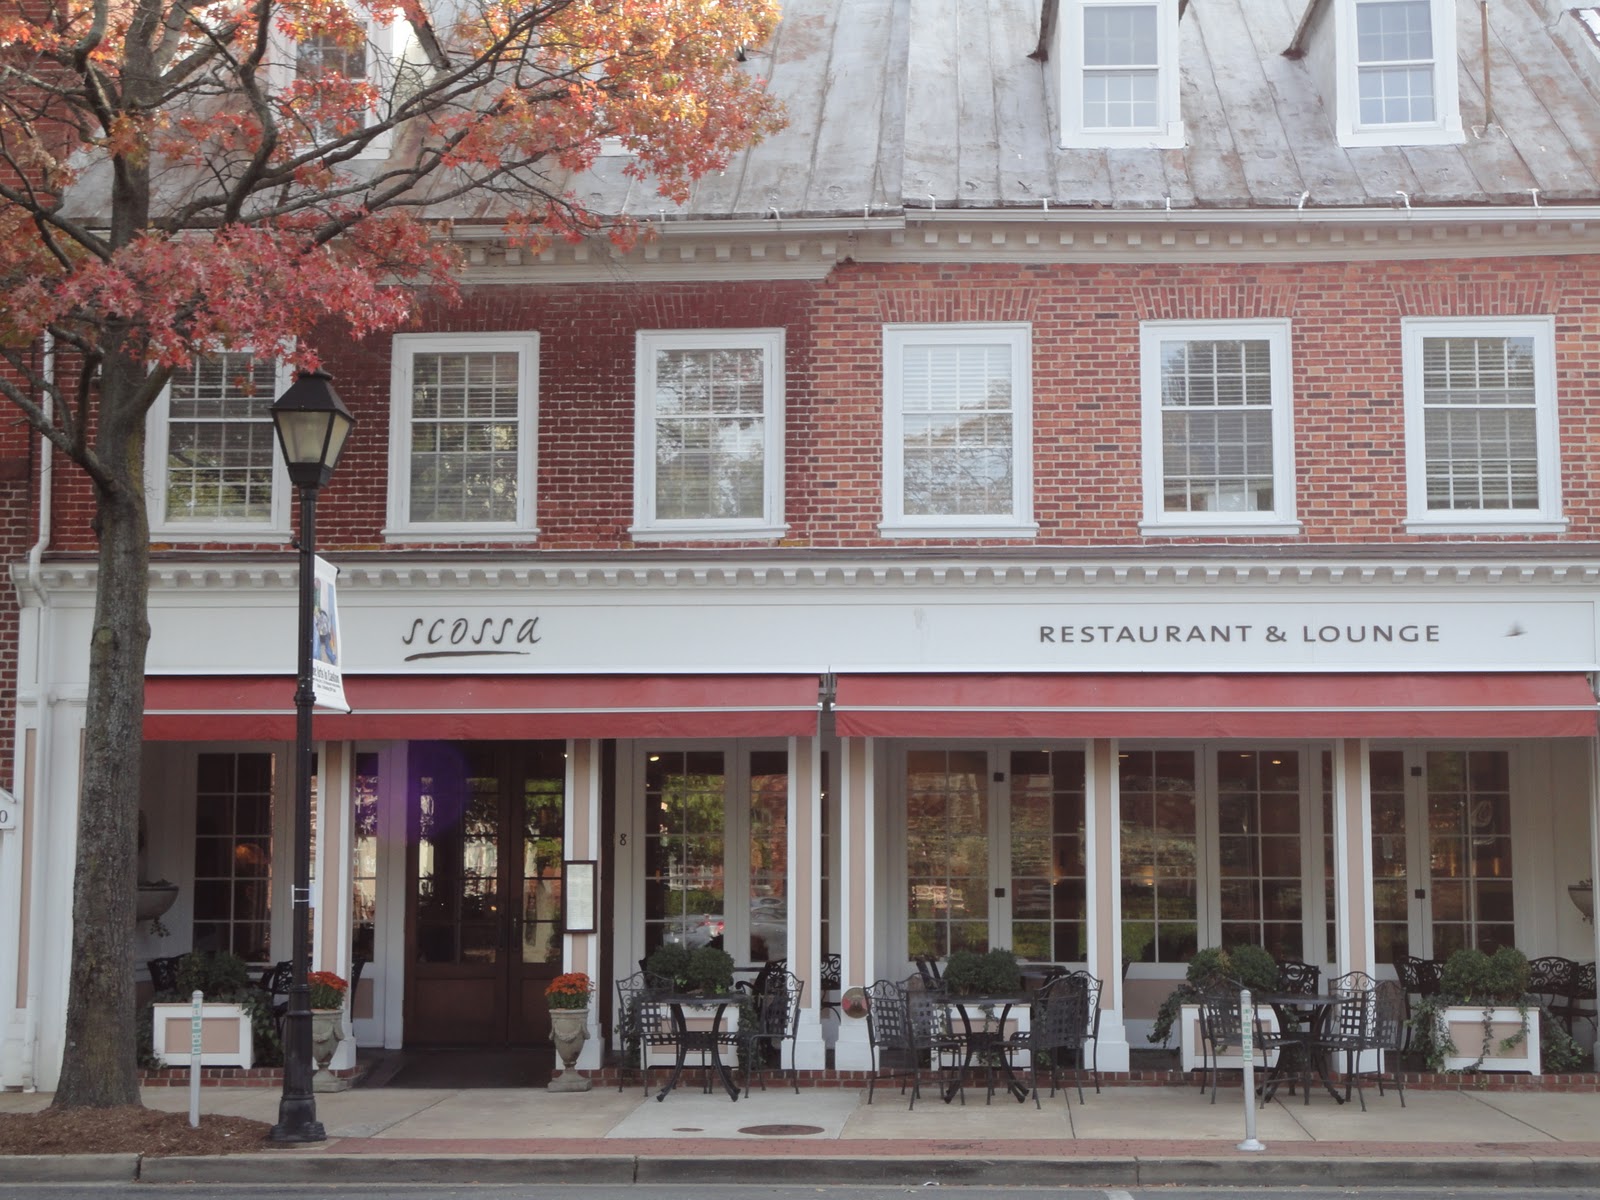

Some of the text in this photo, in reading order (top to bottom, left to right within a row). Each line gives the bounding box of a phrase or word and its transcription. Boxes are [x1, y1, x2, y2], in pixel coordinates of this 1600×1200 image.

[402, 616, 541, 645] scossa
[1040, 625, 1439, 643] RESTAURANT & LOUNGE
[619, 833, 627, 846] 8
